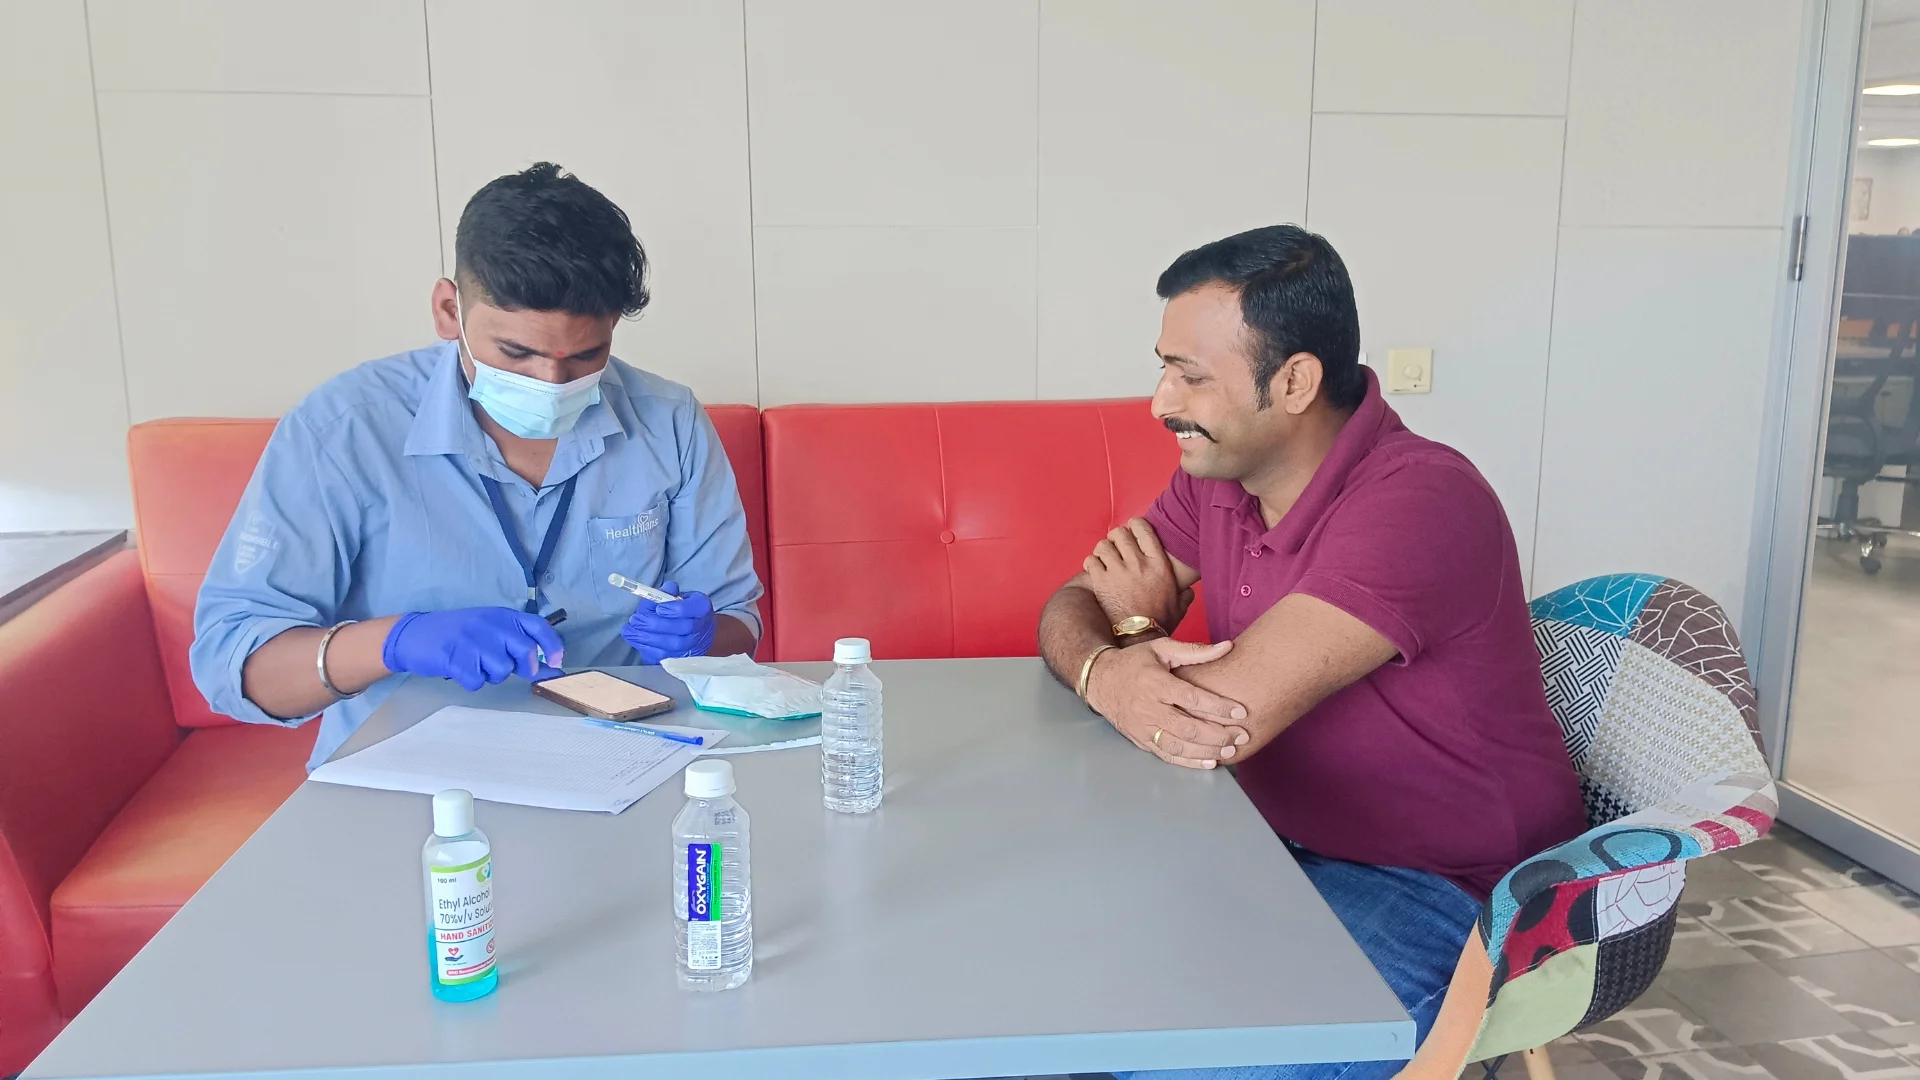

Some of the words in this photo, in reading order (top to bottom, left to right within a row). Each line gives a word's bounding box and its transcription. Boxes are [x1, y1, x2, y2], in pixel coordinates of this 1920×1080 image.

[606, 518, 659, 540] Healthians
[696, 850, 707, 915] OXYGAIN
[439, 897, 460, 912] Ethyl
[463, 887, 490, 907] Alcohol
[440, 909, 473, 925] 70%v/v
[440, 932, 464, 941] HAND
